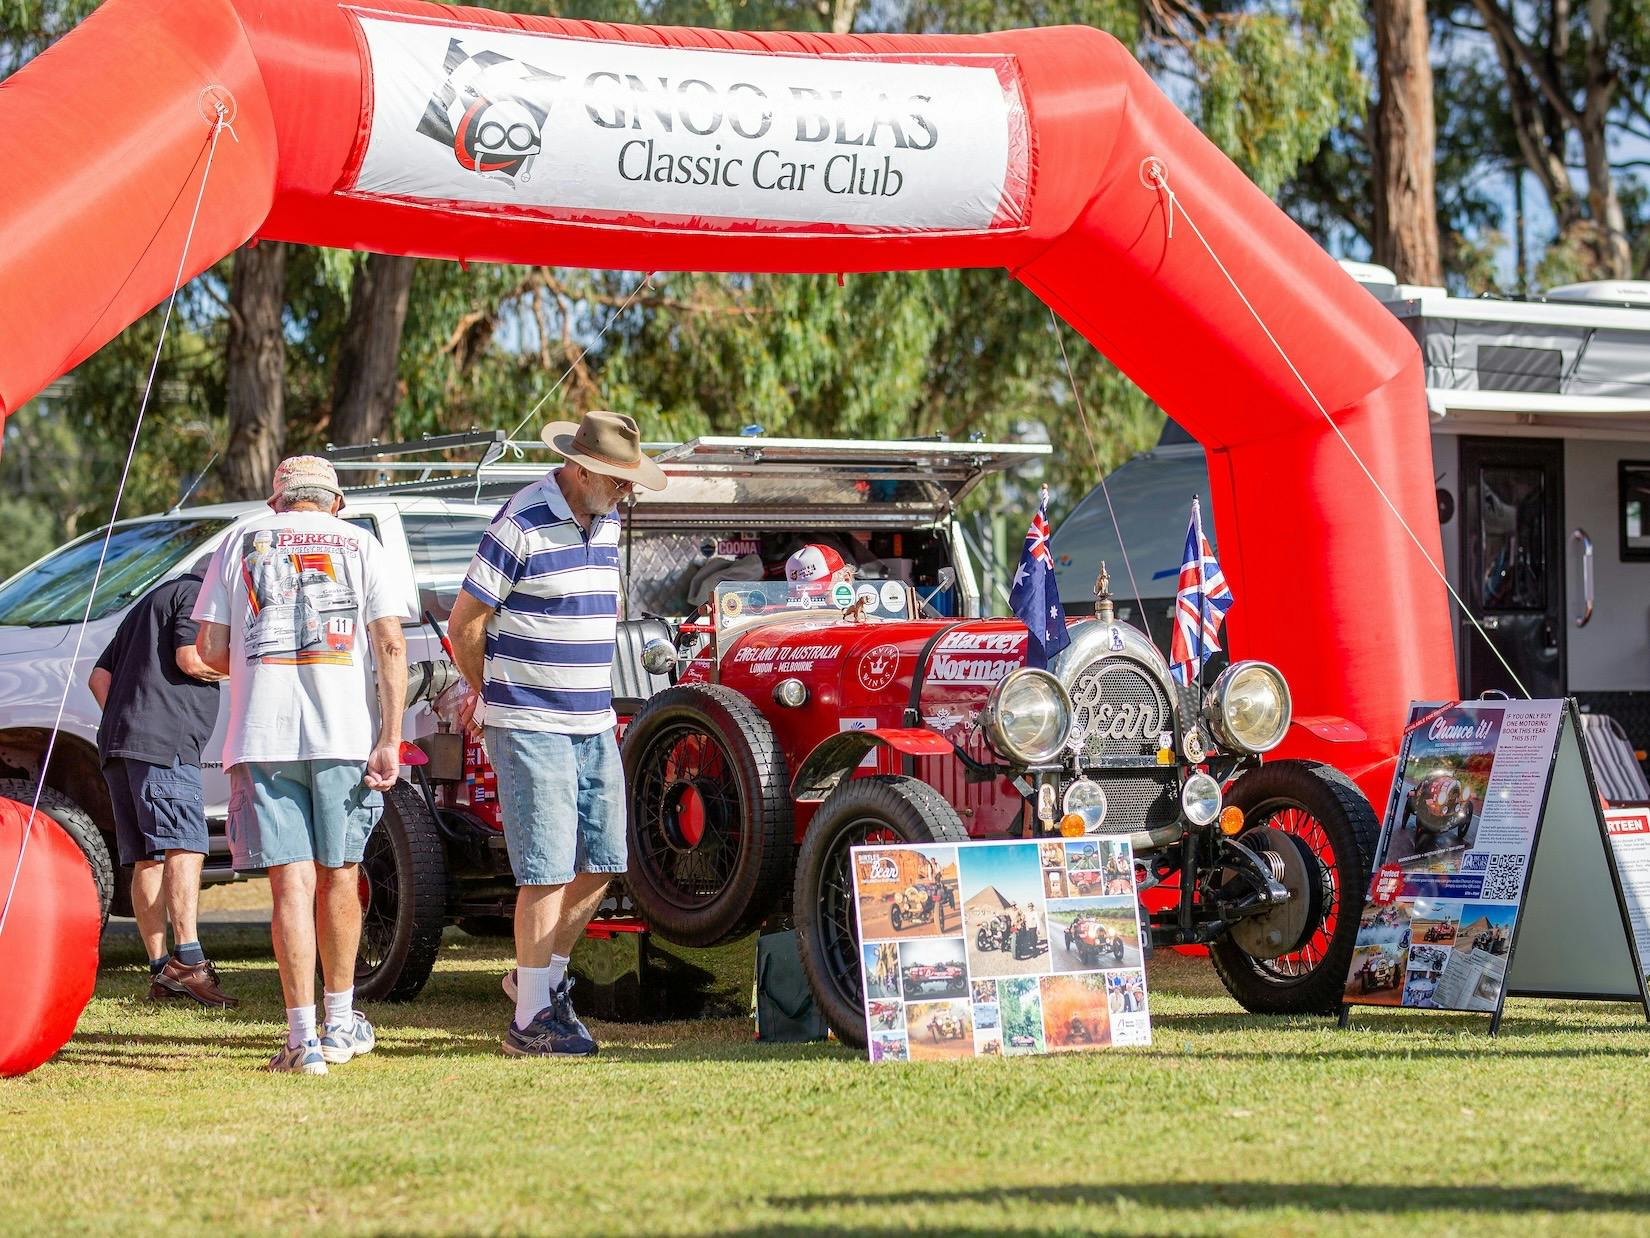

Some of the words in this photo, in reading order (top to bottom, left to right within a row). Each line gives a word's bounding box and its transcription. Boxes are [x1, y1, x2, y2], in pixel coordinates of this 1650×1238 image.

[584, 71, 773, 139] GNOO
[788, 86, 940, 151] BLAS
[618, 139, 742, 186] Classic
[750, 149, 815, 193] Car
[824, 153, 904, 198] Club
[278, 533, 359, 552] PERKINS
[719, 541, 758, 554] COOMA
[335, 618, 347, 633] 11
[938, 631, 1028, 654] Harvey
[734, 646, 776, 662] ENGLAND
[776, 645, 788, 660] TO
[789, 645, 842, 660] AUSTRALIA
[867, 647, 897, 660] IRVINE
[750, 662, 773, 674] LONDON
[778, 661, 814, 673] MELBOURNE
[927, 655, 1020, 680] Norman
[862, 672, 891, 687] WINES
[1073, 664, 1166, 740] Bean
[1428, 716, 1474, 740] Chance
[1475, 720, 1493, 739] it!
[1606, 819, 1644, 832] RTEEN
